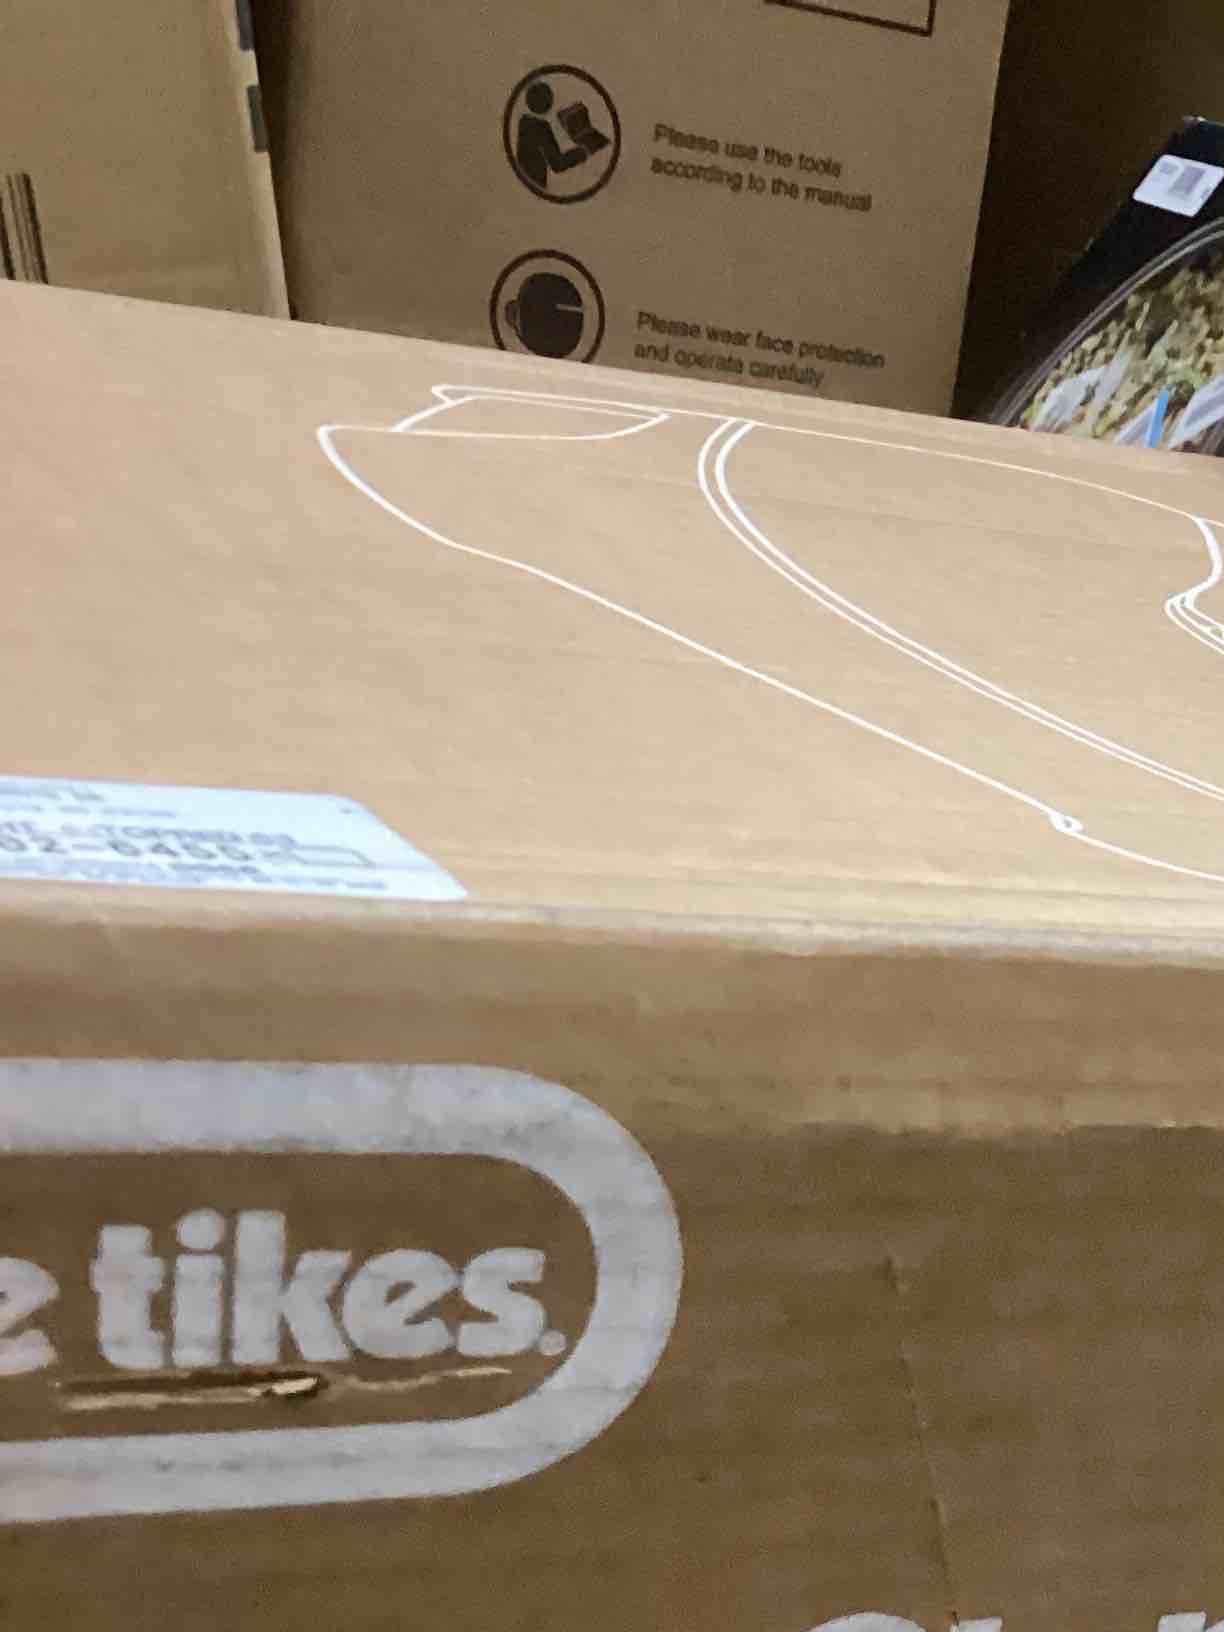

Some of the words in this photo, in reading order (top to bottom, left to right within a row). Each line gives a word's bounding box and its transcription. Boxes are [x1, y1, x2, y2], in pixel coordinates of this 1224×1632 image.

[654, 122, 720, 154] Please
[724, 143, 758, 161] use
[764, 147, 793, 168] the
[798, 153, 842, 178] tools
[651, 157, 743, 193] according
[748, 172, 767, 193] to
[771, 178, 800, 199] the
[805, 186, 873, 213] manual
[634, 343, 669, 362] and
[674, 349, 743, 375] operate
[749, 360, 825, 389] carefully
[637, 311, 701, 339] Please
[705, 325, 751, 347] wear
[756, 330, 793, 354] face
[798, 341, 886, 369] protection
